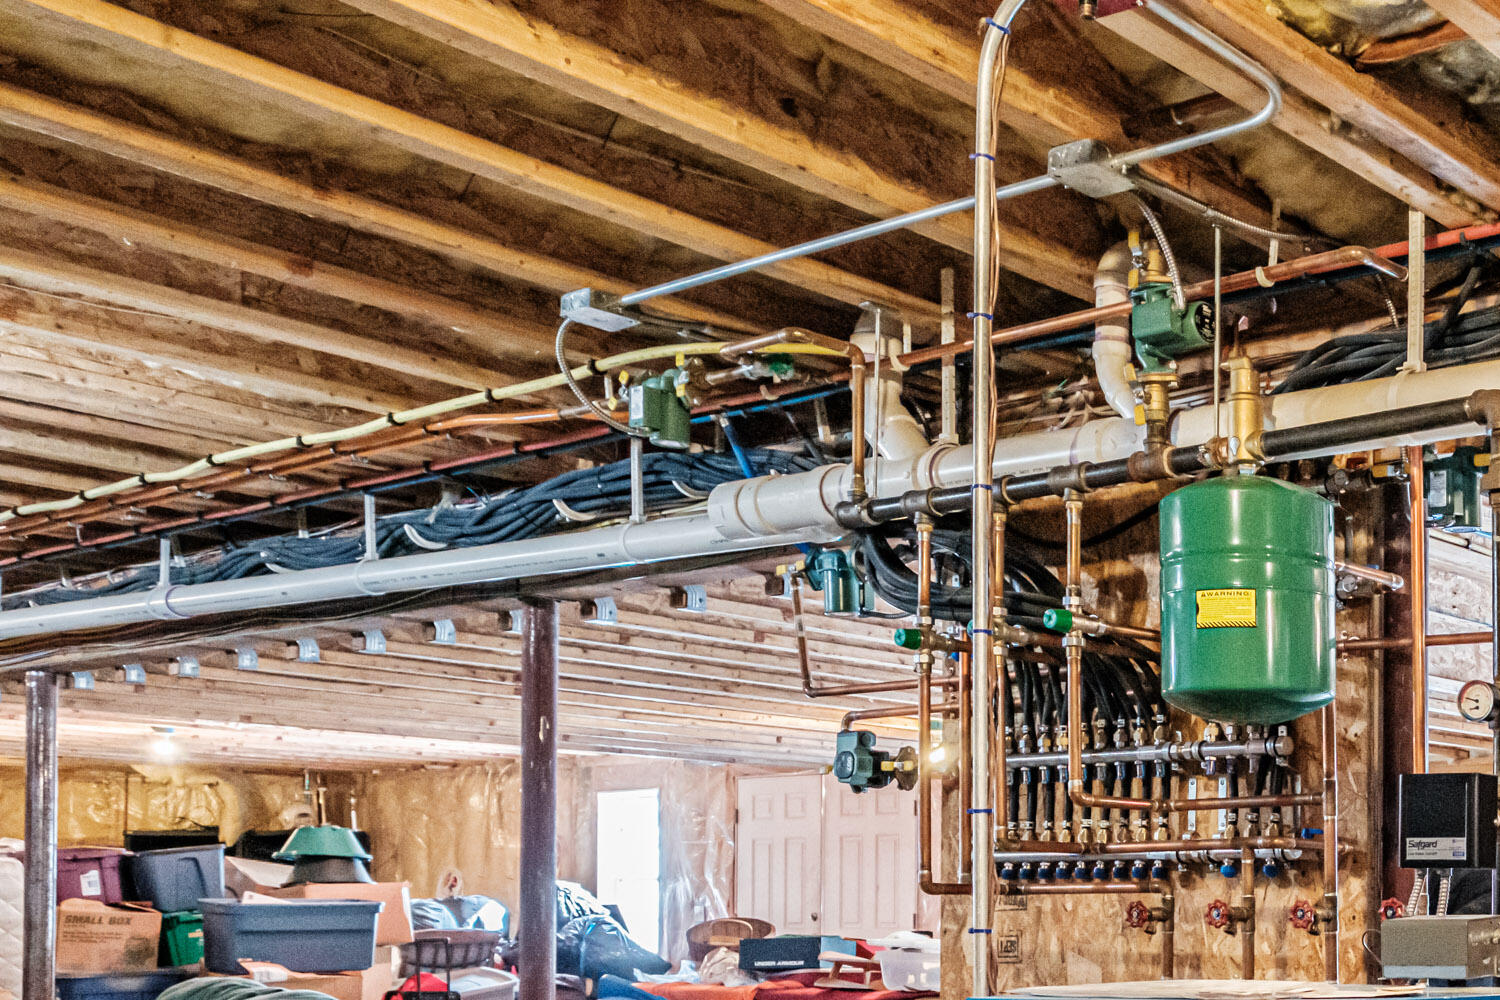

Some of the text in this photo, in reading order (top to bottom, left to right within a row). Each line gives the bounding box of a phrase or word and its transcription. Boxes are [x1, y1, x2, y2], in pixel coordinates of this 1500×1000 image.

[1408, 840, 1438, 850] Safgard
[64, 915, 133, 926] SMALL BOX
